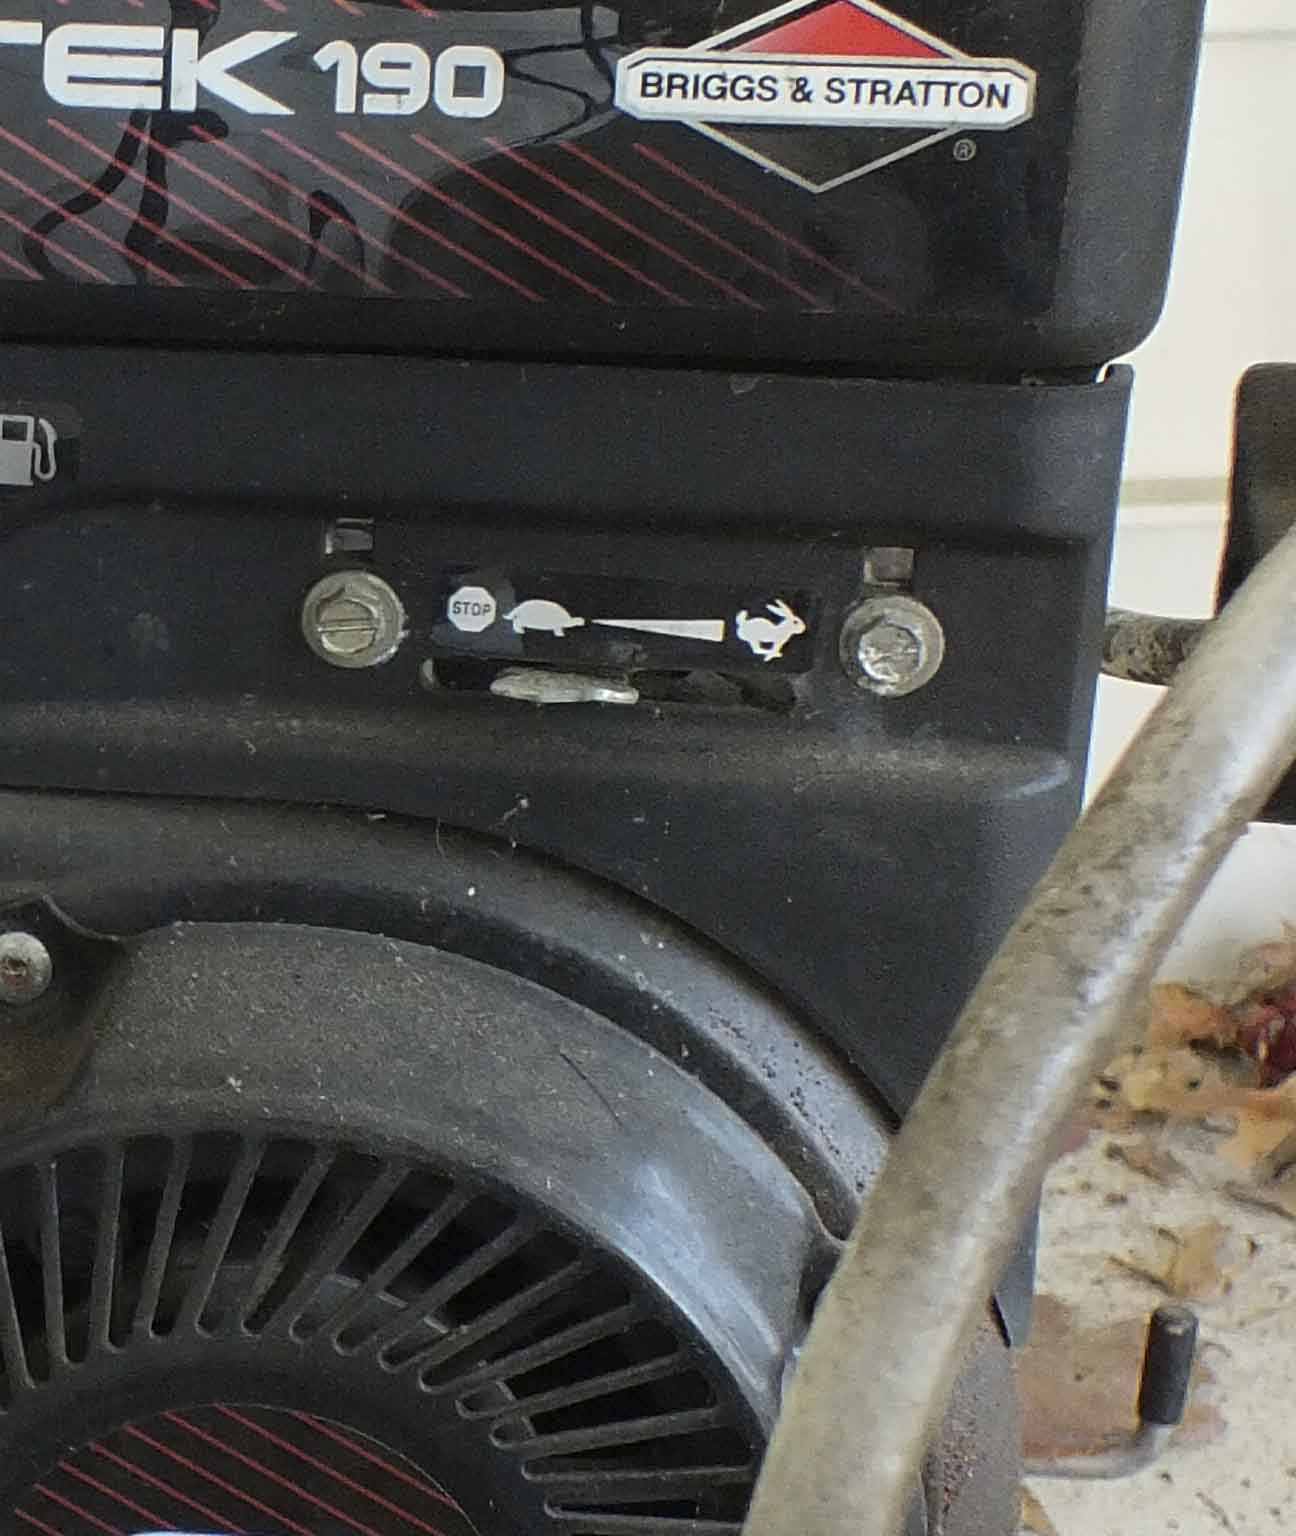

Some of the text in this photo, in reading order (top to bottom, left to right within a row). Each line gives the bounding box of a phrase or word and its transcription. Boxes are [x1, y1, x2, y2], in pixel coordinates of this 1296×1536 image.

[313, 39, 505, 119] 190
[640, 72, 1011, 109] BRIGGS & STRATTON
[451, 599, 492, 617] STOP
